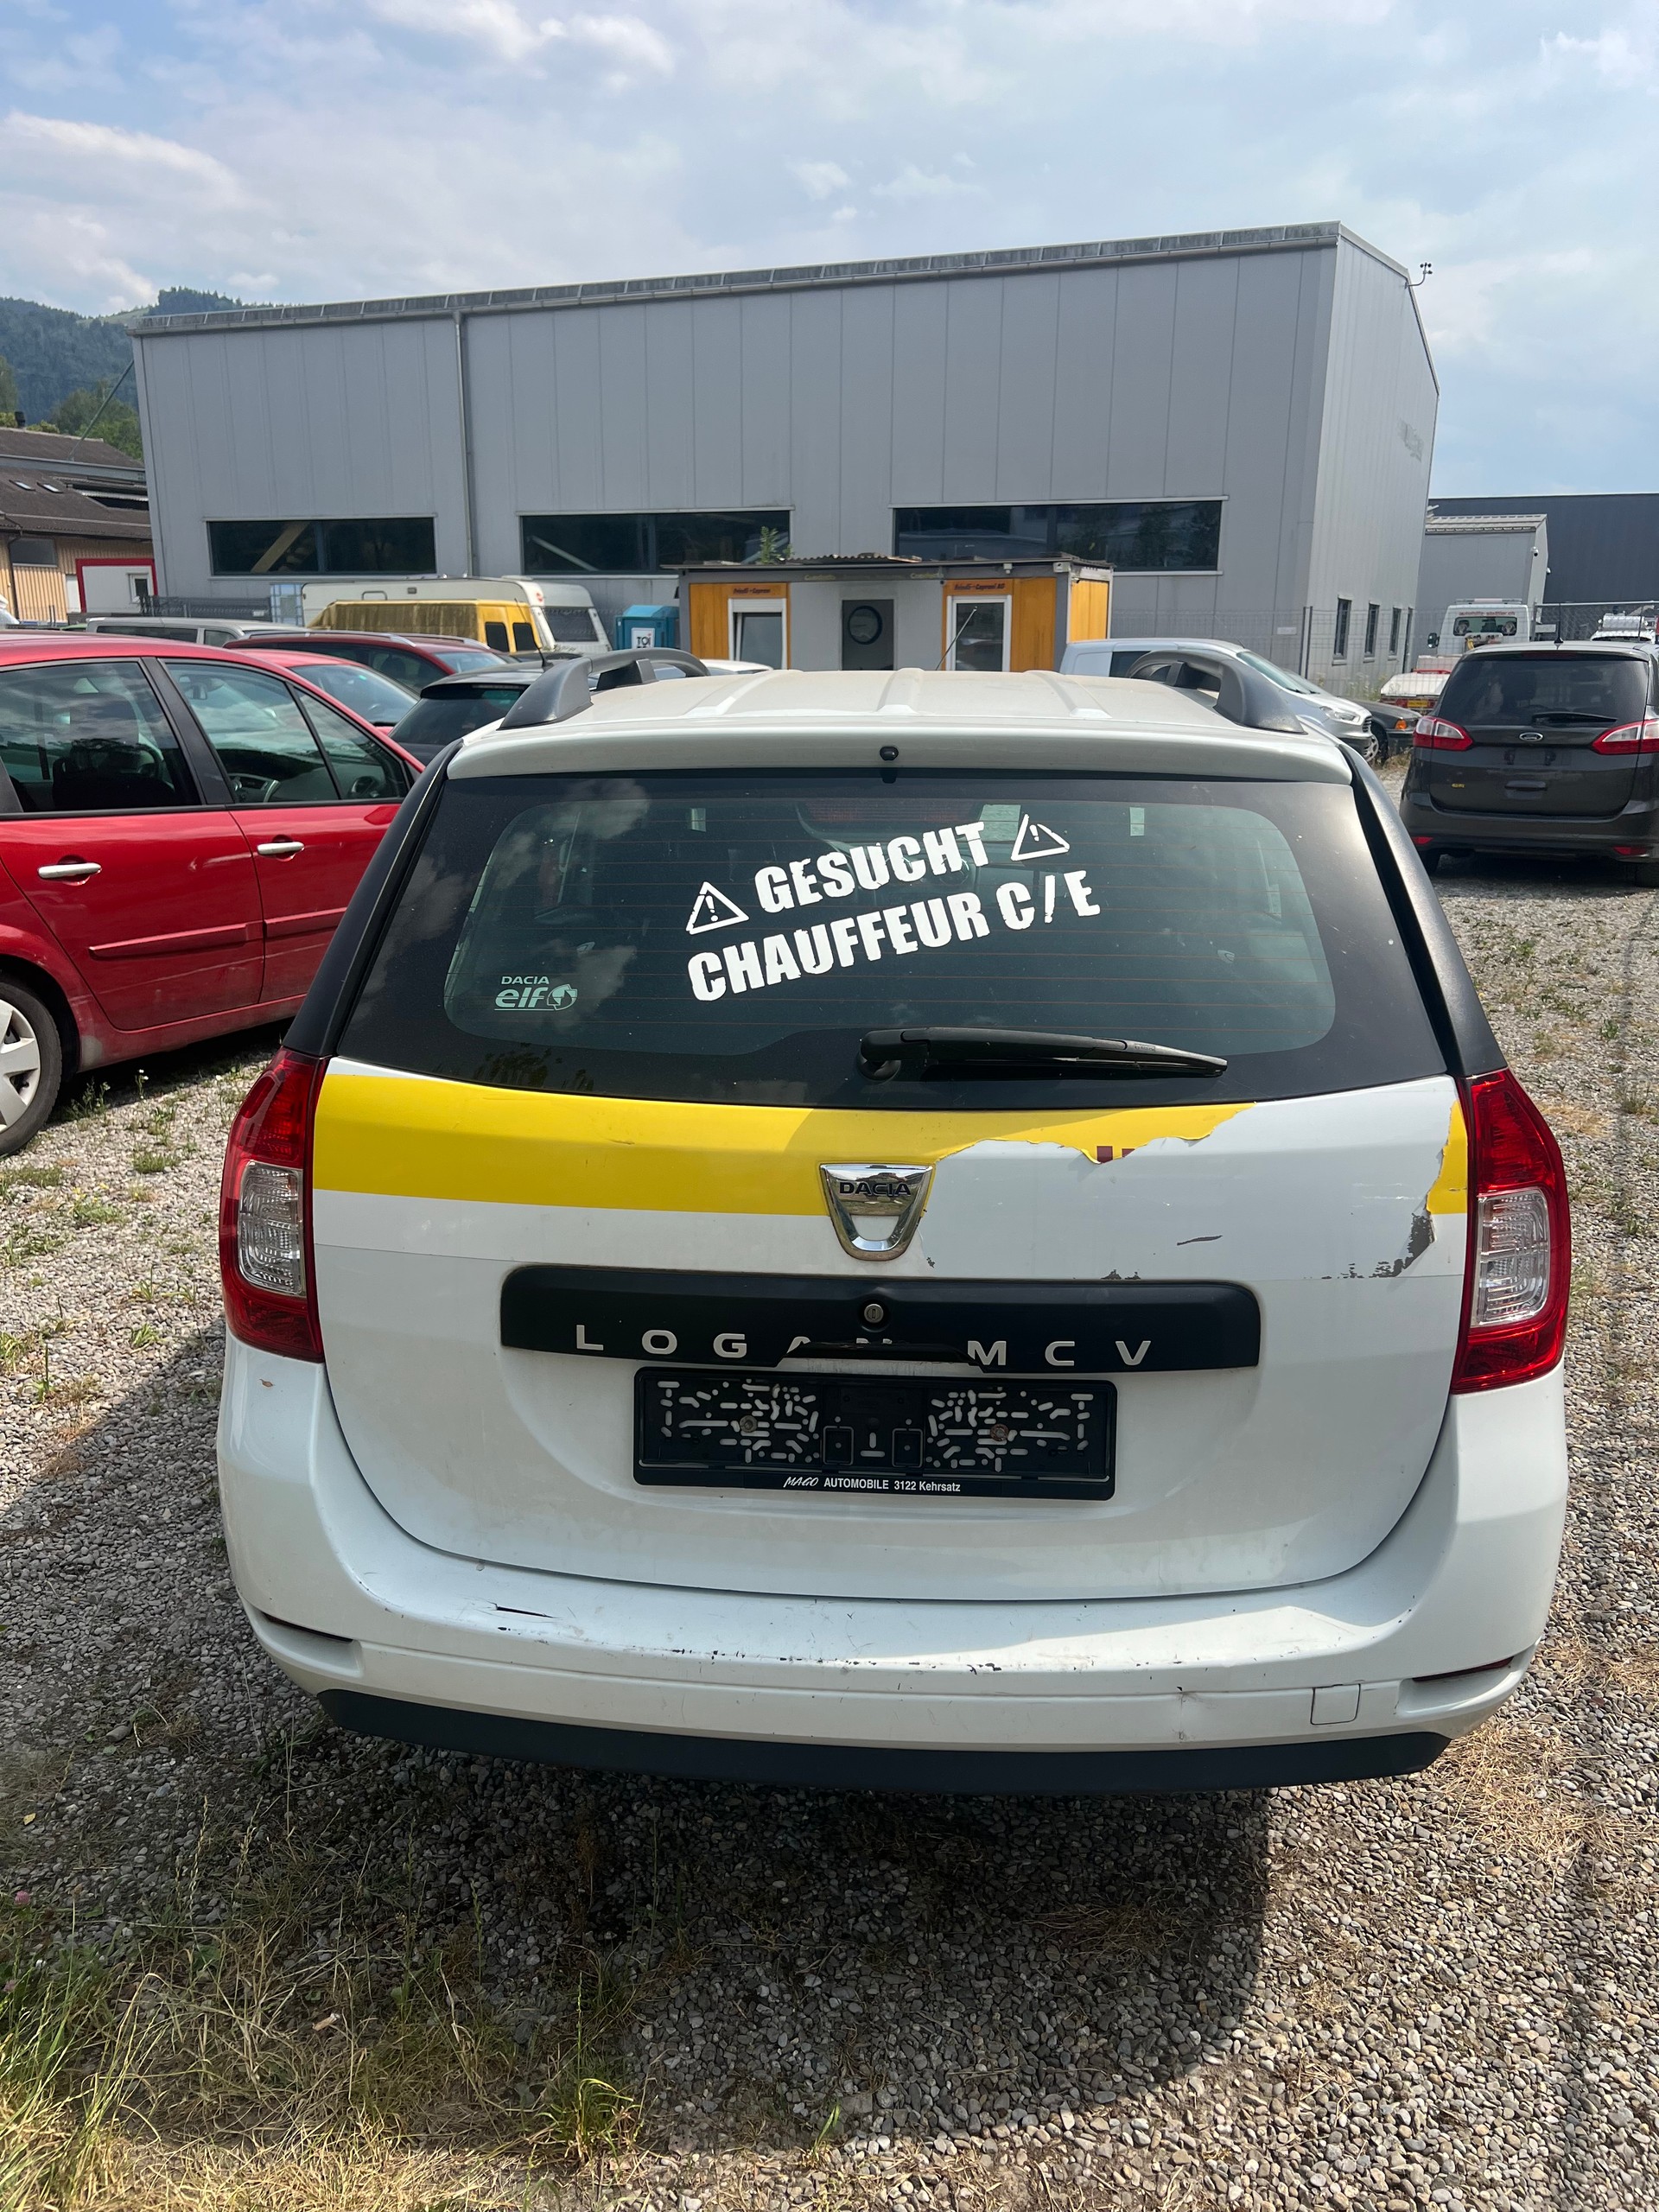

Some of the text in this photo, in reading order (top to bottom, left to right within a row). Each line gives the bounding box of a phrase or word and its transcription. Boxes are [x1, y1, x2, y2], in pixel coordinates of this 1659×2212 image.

[754, 821, 989, 913] GESUCHT
[687, 892, 990, 1001] CHAUFFEUR
[501, 976, 550, 985] DACIA
[495, 987, 549, 1008] elf
[839, 1182, 912, 1197] DACIA
[576, 1325, 893, 1358] LOG
[783, 1476, 961, 1492] MAGO AUTOMOBILE 3122 Kehrsatz
